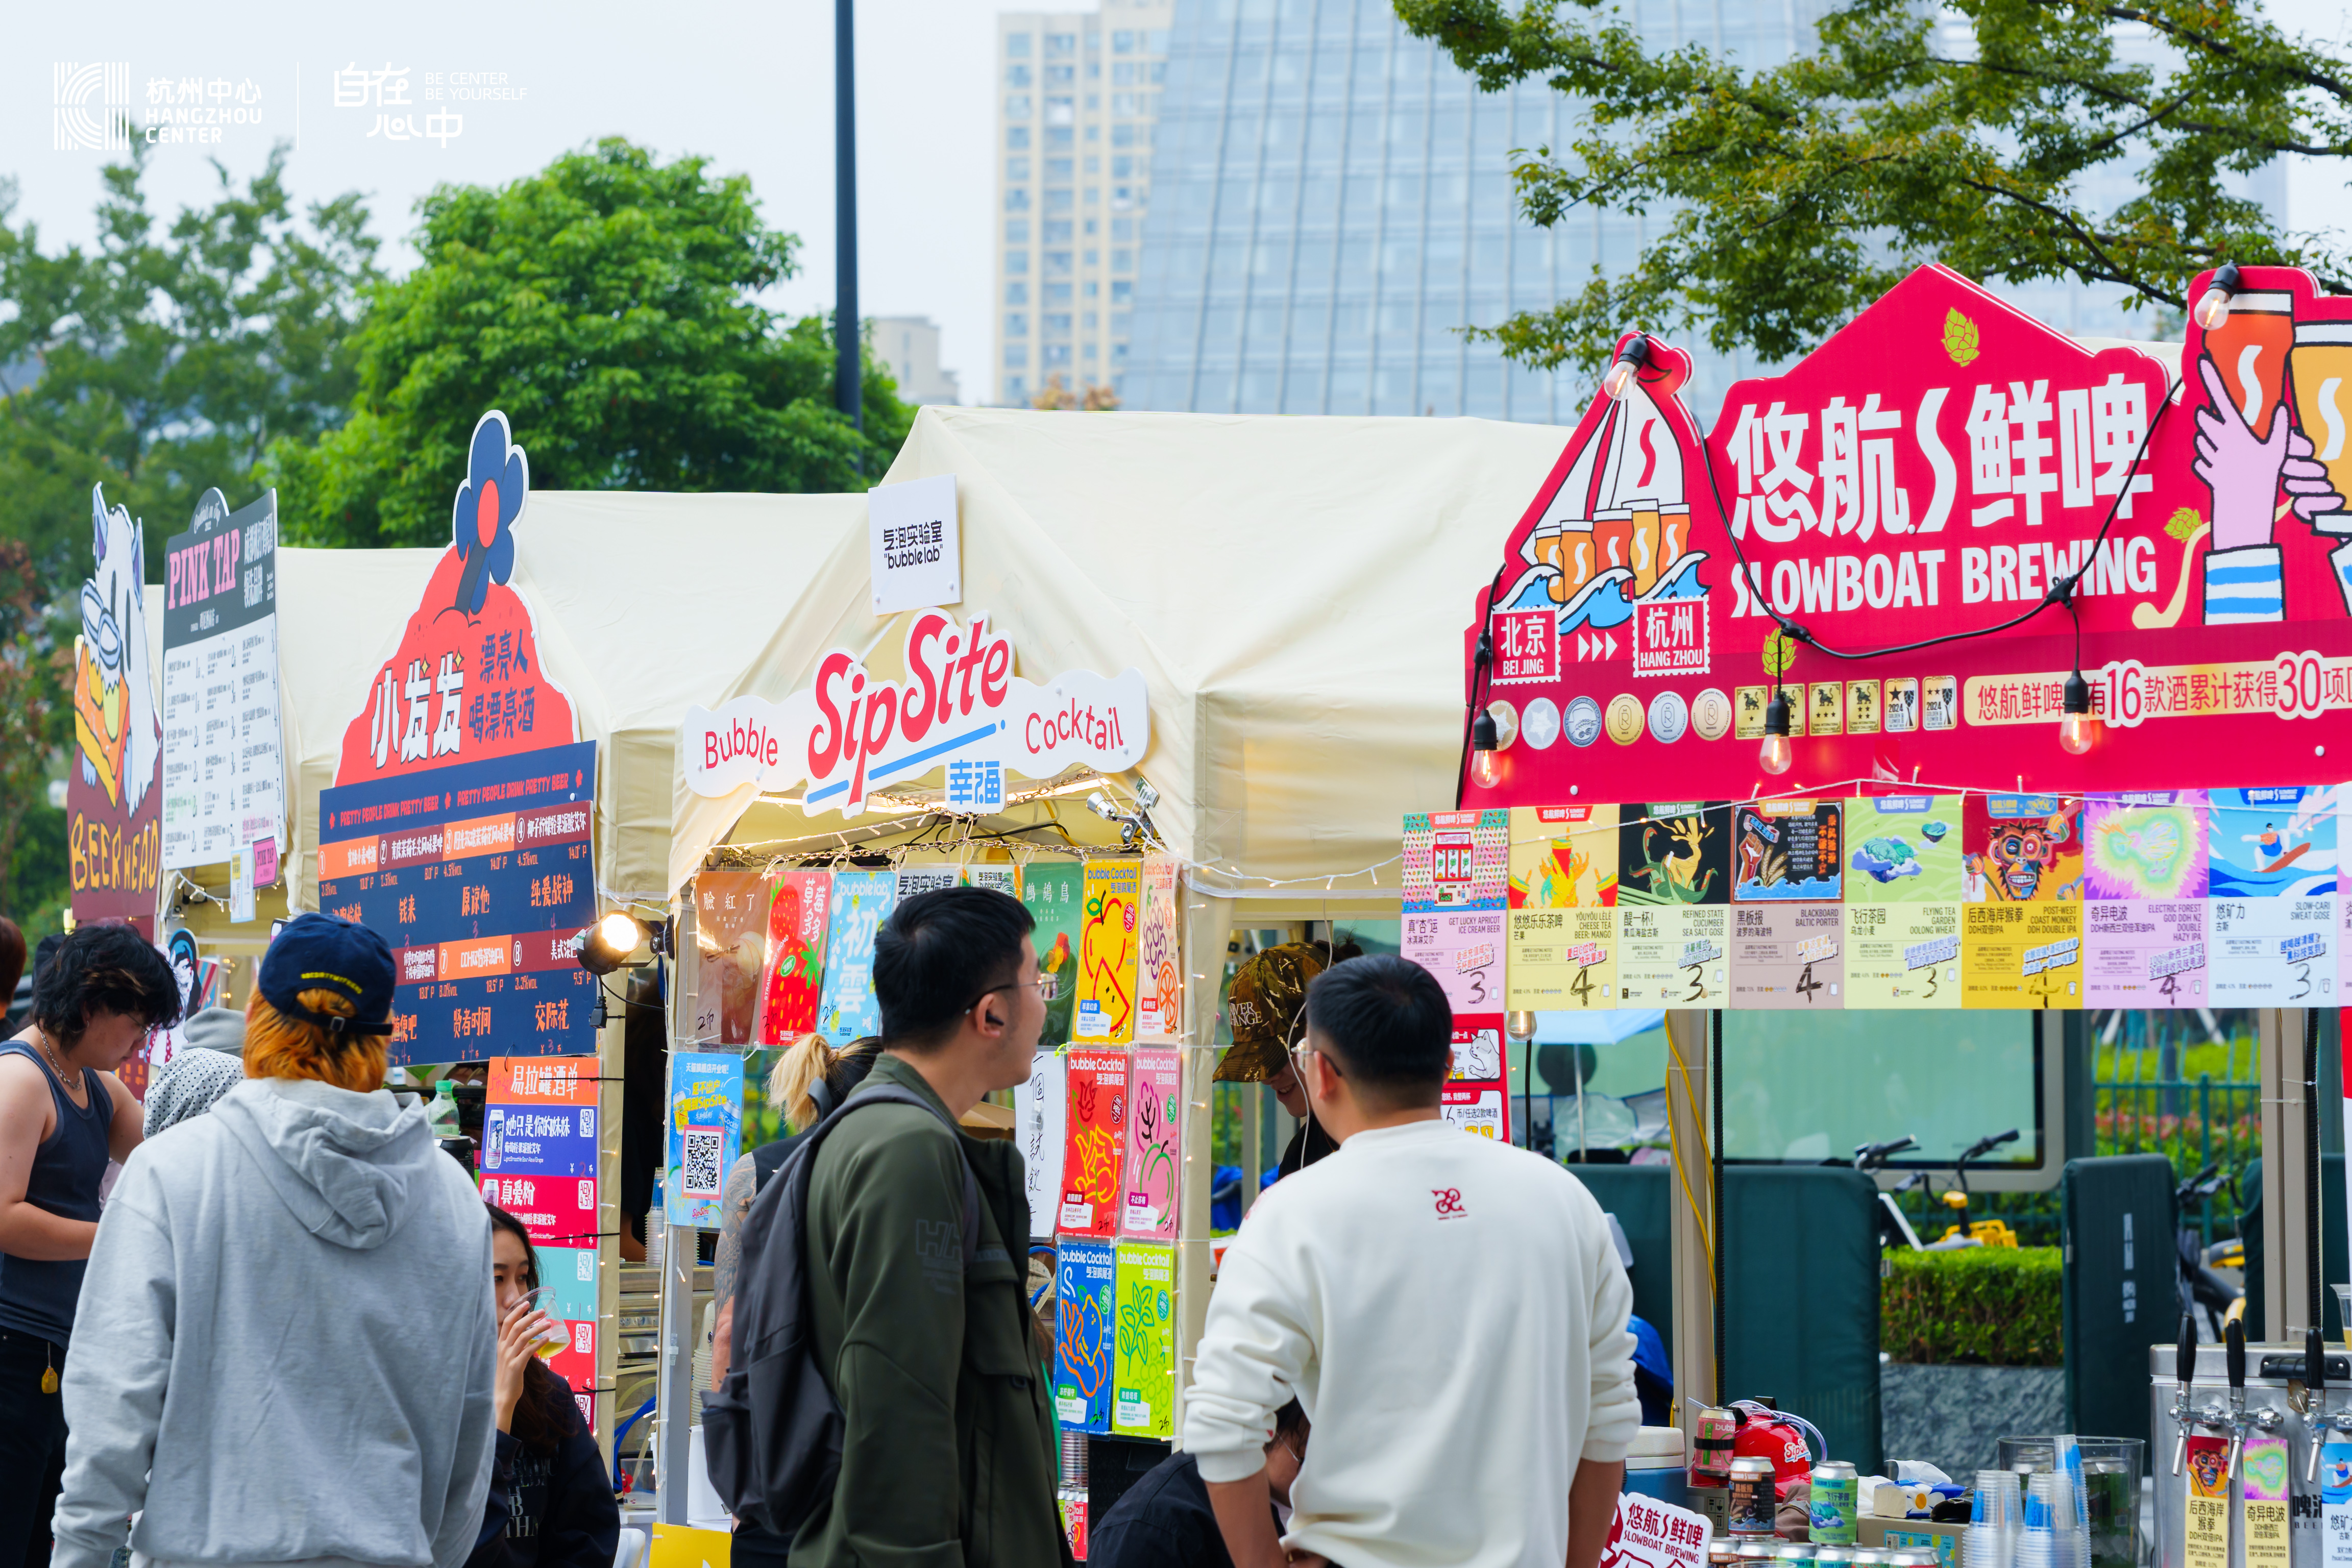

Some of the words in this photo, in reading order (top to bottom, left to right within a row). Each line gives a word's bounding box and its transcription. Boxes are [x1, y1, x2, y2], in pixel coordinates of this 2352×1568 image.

[884, 521, 943, 551] 气泡实验室
[168, 541, 210, 609] PINK
[214, 529, 239, 595] TAP
[1731, 550, 1945, 618] SLOWBOAT
[1962, 537, 2155, 605] BREWING
[1501, 616, 1546, 657] 北京
[1646, 605, 1693, 649] 杭州
[480, 629, 528, 684] 漂亮人
[1640, 651, 1671, 668] HANG
[1673, 649, 1702, 665] ZHOU
[1503, 662, 1518, 676] BEI
[1521, 658, 1544, 675] JING
[469, 685, 535, 744] 喝漂亮酒
[1889, 703, 1903, 712] 2024
[1927, 701, 1942, 710] 2024
[1026, 697, 1123, 754] Cocktail
[705, 718, 778, 769] Bubble
[457, 789, 481, 806] PRETTY
[482, 784, 505, 803] PEOPLE
[506, 781, 524, 798] DRINK
[525, 776, 550, 795] PRETTY
[552, 773, 568, 790] BEER
[949, 760, 1000, 804] 幸福
[340, 809, 361, 827] PRETTY
[362, 805, 382, 823] PEOPLE
[384, 803, 399, 819] DRINK
[401, 797, 423, 815] PRETTY
[424, 795, 438, 812] BEER
[1088, 868, 1109, 879] bubble
[1111, 867, 1136, 879] Cocktail
[531, 873, 573, 906] 纯爱战神
[462, 885, 489, 916] 原谅他
[1478, 916, 1500, 924] APRICOT
[1737, 910, 1763, 925] 黑板报
[1851, 909, 1885, 924] 飞行茶园
[1968, 908, 2023, 923] 后西海岸猴拳
[2091, 906, 2127, 921] 奇异电波
[2217, 903, 2245, 919] 悠矿力
[2314, 911, 2330, 919] GOSE
[1514, 914, 1562, 929] 悠悠乐乐茶啤
[1851, 926, 1875, 935] 乌龙小麦
[1969, 925, 2004, 934] DDH双倍IPA
[2216, 922, 2228, 932] 古斯
[1407, 936, 1434, 945] 冰淇淋艾尔
[1514, 932, 1525, 940] 芒果
[1624, 928, 1658, 937] 黄瓜海盐古斯
[1736, 927, 1772, 937] 波罗的海波特
[764, 953, 779, 1000] STRAWBERRY
[777, 935, 789, 952] MOMO
[1468, 971, 1485, 1003] 3
[1571, 966, 1596, 1007] 4
[1683, 964, 1703, 1002] 3
[1796, 963, 1823, 1003] 4
[1923, 967, 1937, 998] 3
[2029, 969, 2061, 1008] 4
[2159, 975, 2181, 1006] 4
[2289, 963, 2311, 1000] 3
[453, 1007, 491, 1038] 贤者时间
[535, 999, 569, 1032] 交际花
[1071, 1058, 1096, 1071] bubble
[1097, 1059, 1124, 1071] Cocktail
[1137, 1057, 1156, 1070] bubble
[1156, 1059, 1176, 1071] Cocktail
[511, 1063, 577, 1099] 易拉罐酒单
[1457, 1108, 1498, 1118] 币/任选2款啤酒
[506, 1115, 570, 1137] 她只是你的妹妹
[501, 1179, 535, 1206] 真爱粉
[1062, 1250, 1086, 1263] bubble
[1087, 1252, 1112, 1264] Cocktail
[1120, 1254, 1143, 1265] bubble
[1143, 1254, 1169, 1267] Cocktail
[2190, 1500, 2224, 1517] 后西海岸
[2247, 1506, 2285, 1522] 奇异电波
[2198, 1516, 2215, 1531] 猴拳
[1624, 1530, 1663, 1551] SLOWBOAT
[1665, 1544, 1699, 1564] BREWING
[2190, 1532, 2223, 1542] DDH双倍IPA
